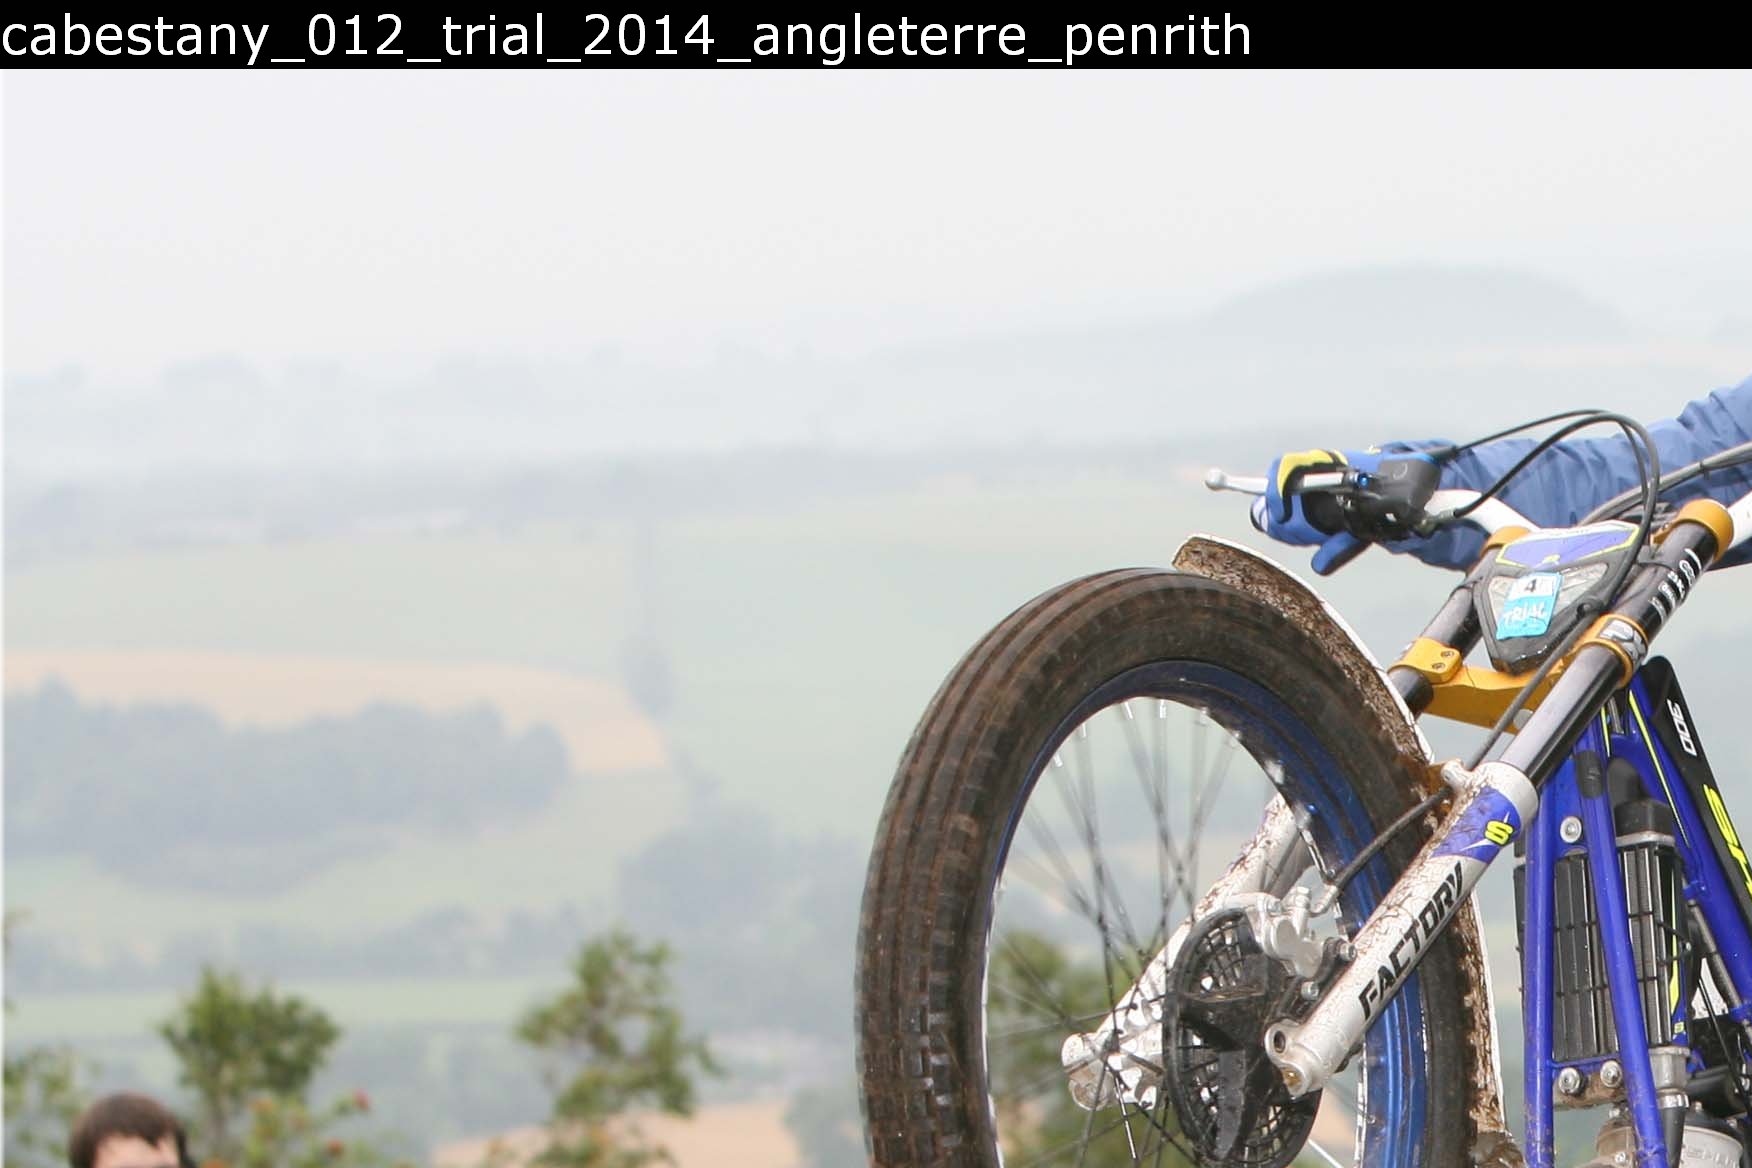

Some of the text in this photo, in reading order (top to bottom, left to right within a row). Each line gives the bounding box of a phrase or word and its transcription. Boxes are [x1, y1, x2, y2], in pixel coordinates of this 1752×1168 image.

[1524, 578, 1538, 593] 4
[1666, 698, 1698, 757] 300
[1358, 861, 1463, 1021] FACTORY
